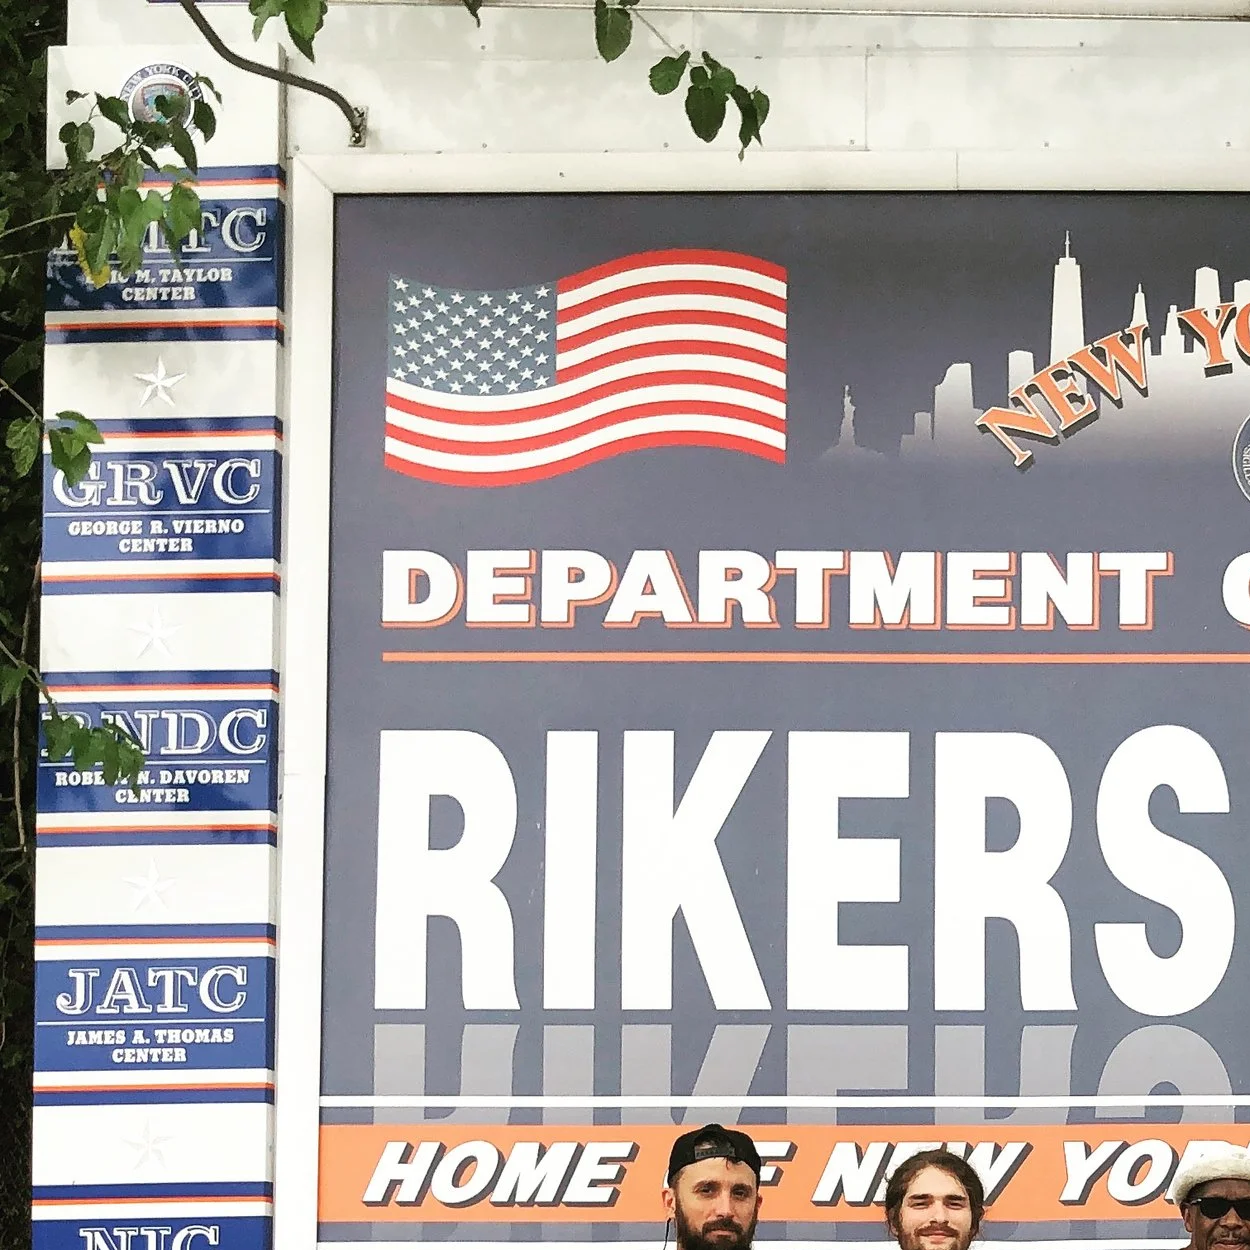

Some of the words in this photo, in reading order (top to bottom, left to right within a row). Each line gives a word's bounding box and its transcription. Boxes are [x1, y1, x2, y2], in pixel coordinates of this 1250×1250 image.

[159, 267, 233, 282] TAYLOR
[121, 287, 196, 301] CENTER
[975, 324, 1150, 472] NEW
[52, 459, 261, 507] GRVC
[68, 520, 142, 536] GEORGE
[150, 519, 168, 535] R.
[172, 518, 244, 534] VIERNO
[118, 538, 193, 553] CENTER
[380, 549, 1174, 631] DEPARTMENT
[55, 769, 130, 786] ROBE
[160, 769, 250, 785] DAVOREN
[115, 788, 190, 803] CENTER
[374, 724, 1236, 1017] RIKERS
[55, 965, 247, 1015] JATC
[67, 1030, 126, 1045] JAMES
[132, 1030, 150, 1044] A.
[154, 1028, 234, 1044] THOMAS
[112, 1047, 187, 1063] CENTER
[361, 1140, 640, 1208] HOME
